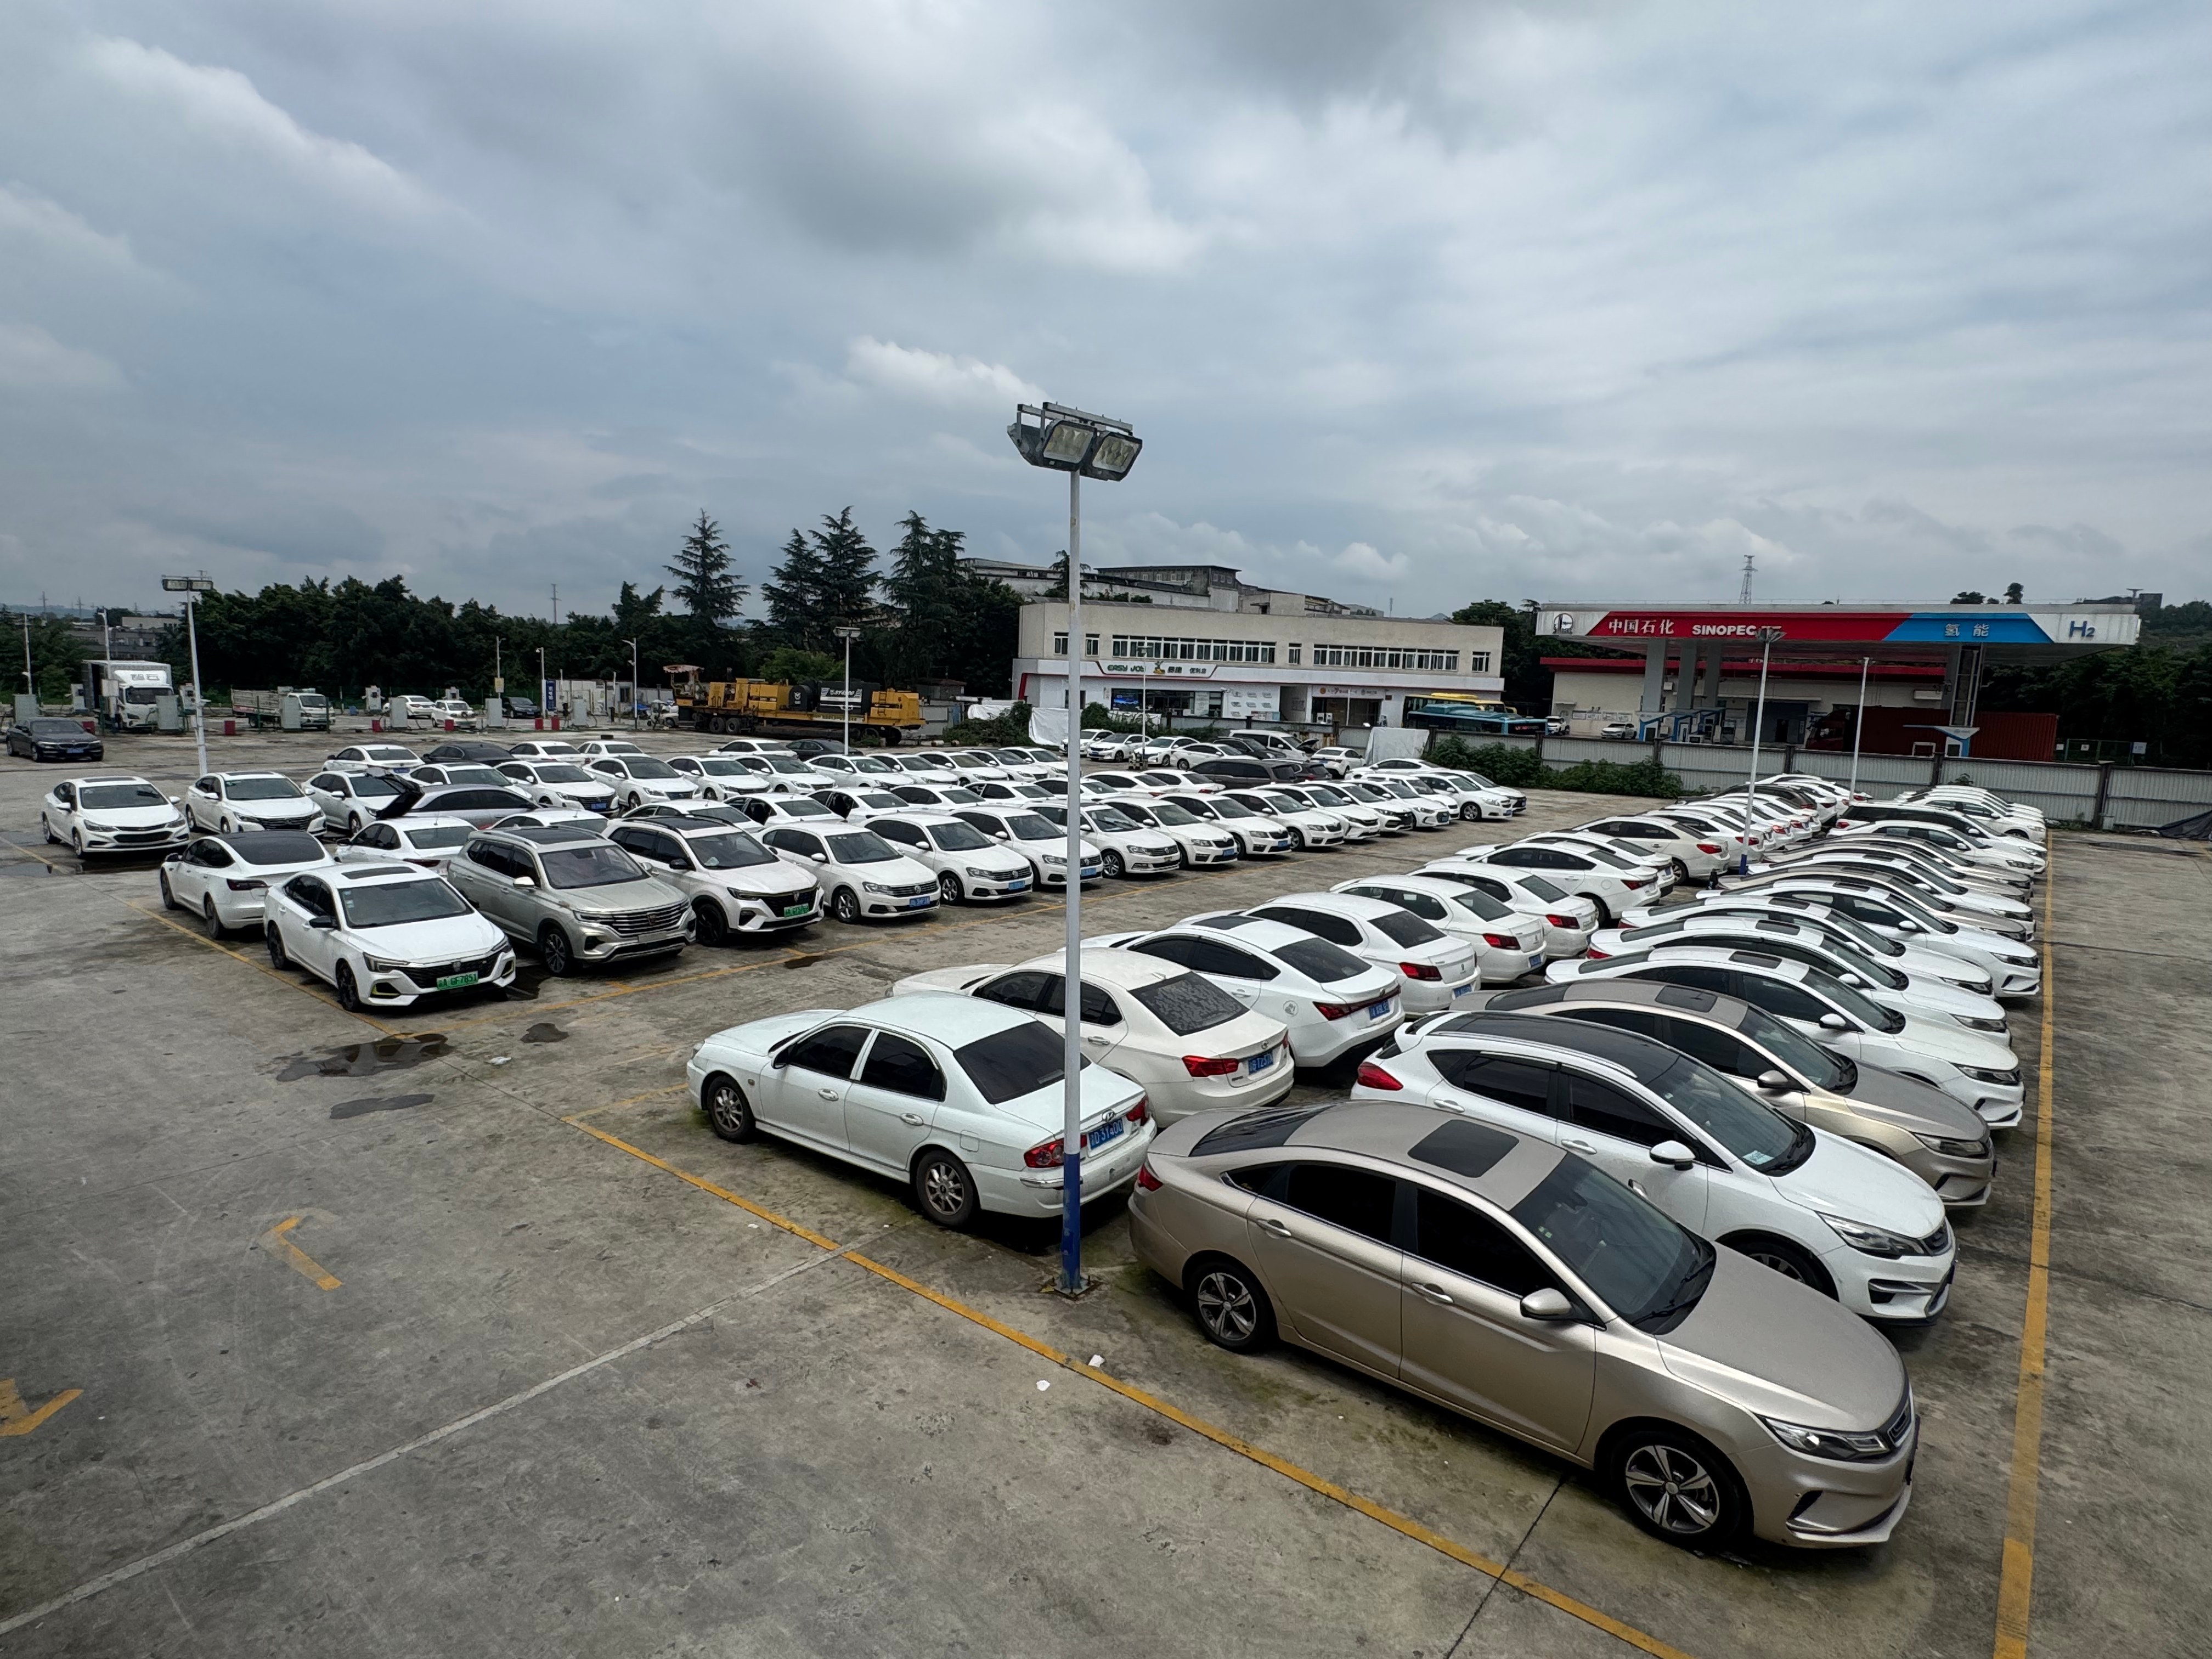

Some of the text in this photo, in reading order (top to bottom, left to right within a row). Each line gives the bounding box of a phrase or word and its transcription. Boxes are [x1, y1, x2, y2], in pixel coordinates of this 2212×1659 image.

[1609, 619, 1674, 634] 中国石化
[1692, 624, 1757, 635] SINOPEC
[1945, 623, 1989, 636] 氢能
